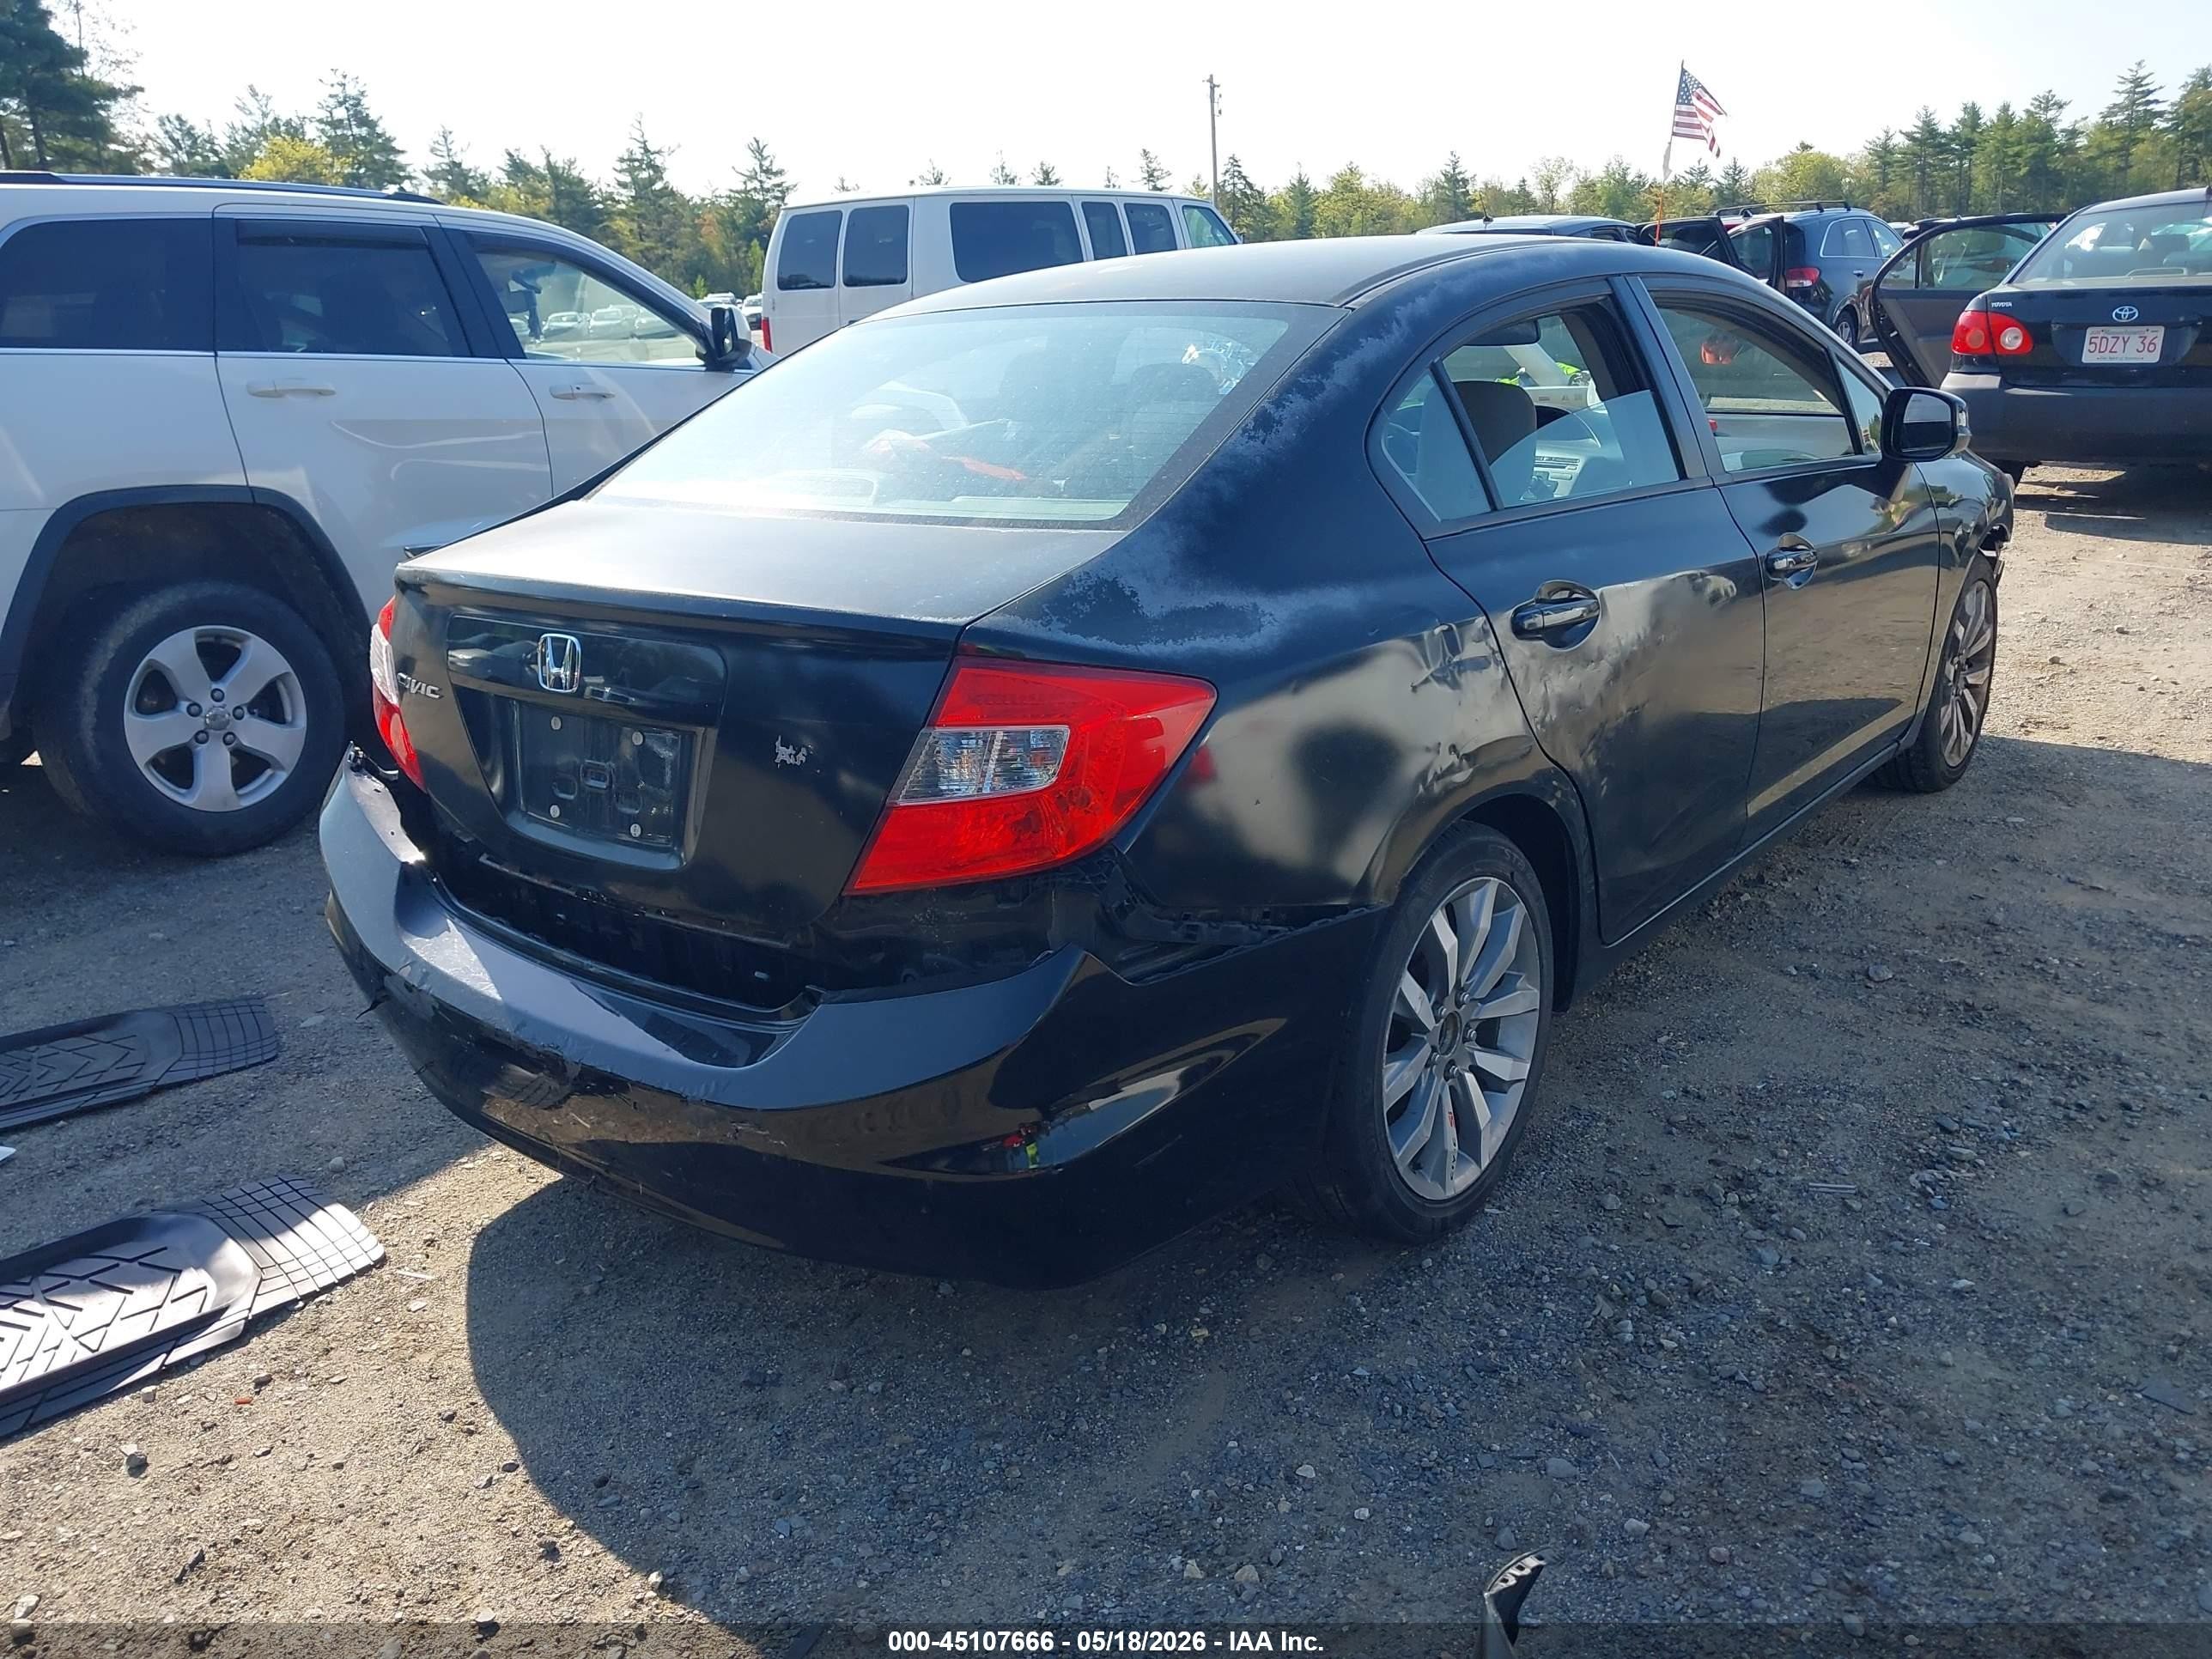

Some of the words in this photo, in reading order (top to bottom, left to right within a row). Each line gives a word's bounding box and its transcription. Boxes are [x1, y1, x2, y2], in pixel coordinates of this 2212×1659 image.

[2087, 336, 2130, 354] 5DZY
[2136, 336, 2158, 354] 36
[397, 672, 441, 699] CIVIC
